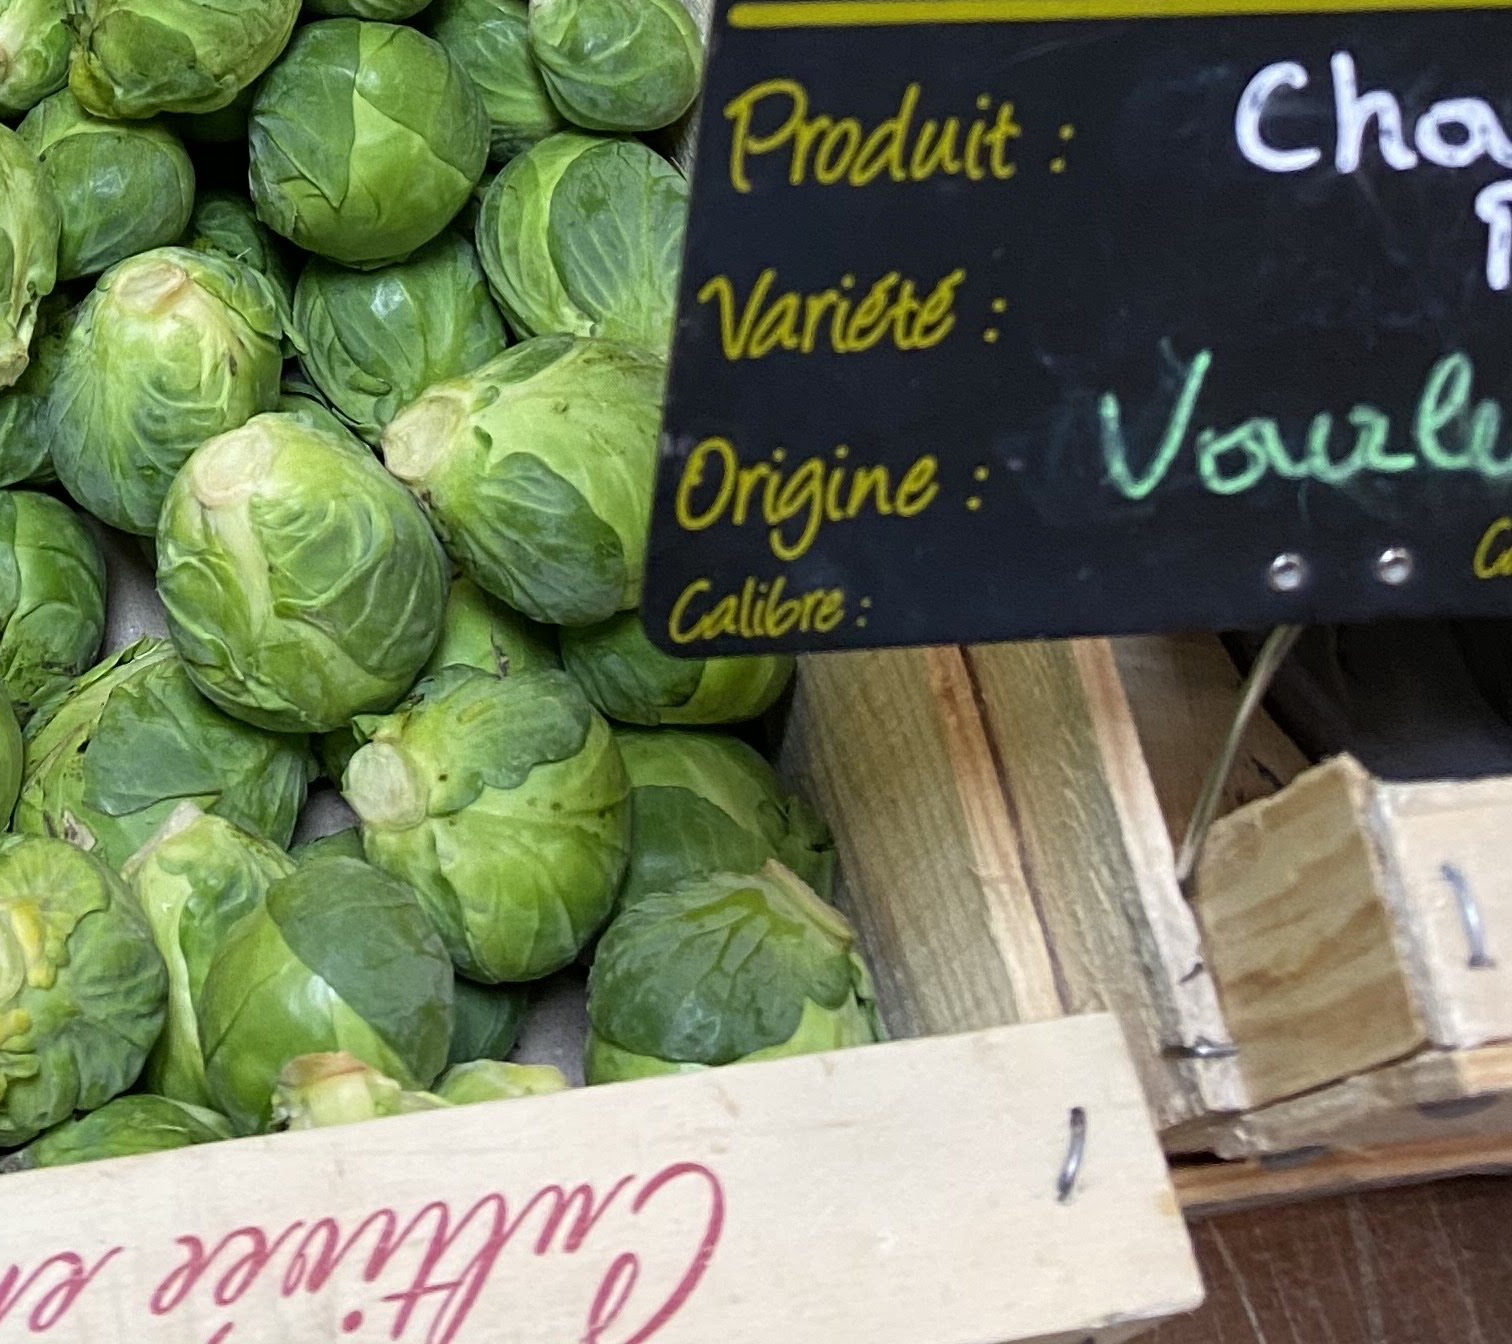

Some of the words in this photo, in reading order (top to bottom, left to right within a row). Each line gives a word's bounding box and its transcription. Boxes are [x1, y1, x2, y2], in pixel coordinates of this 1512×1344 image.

[724, 78, 1021, 195] Produit
[697, 267, 968, 362] Variété
[674, 434, 941, 562] Origine
